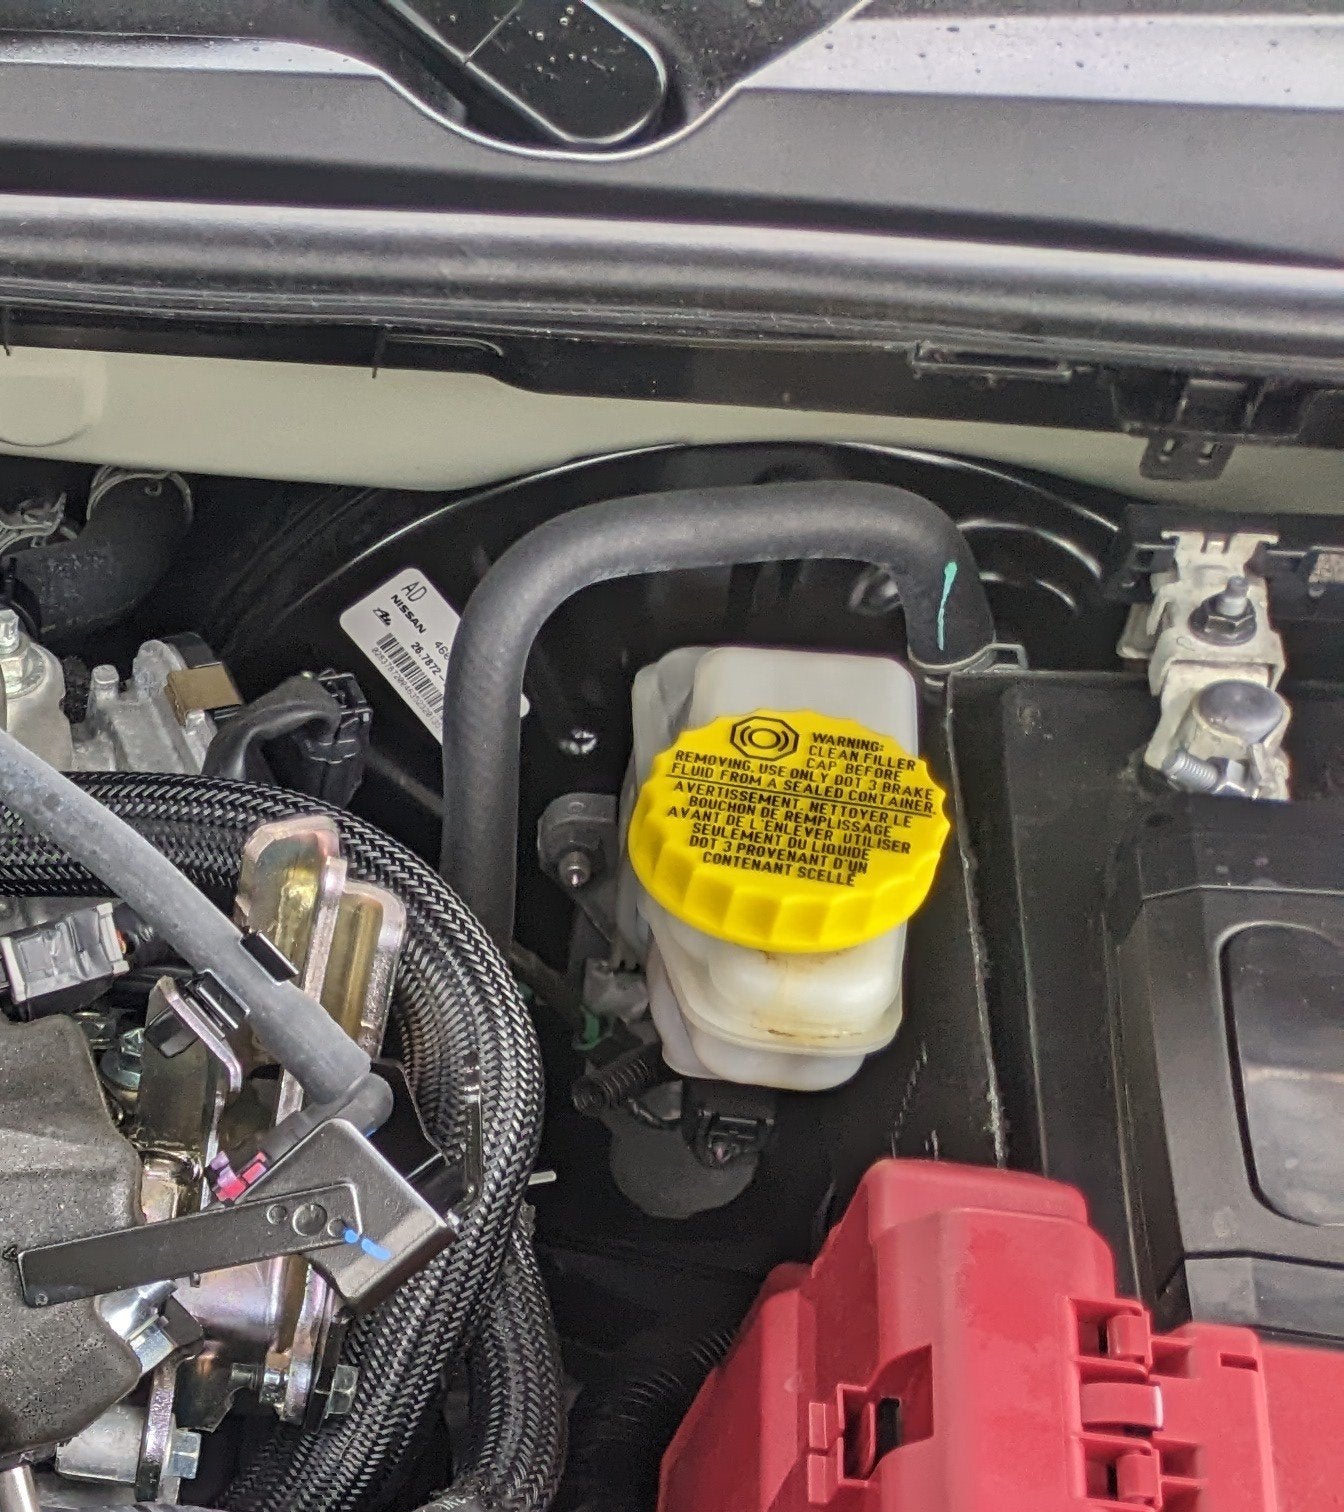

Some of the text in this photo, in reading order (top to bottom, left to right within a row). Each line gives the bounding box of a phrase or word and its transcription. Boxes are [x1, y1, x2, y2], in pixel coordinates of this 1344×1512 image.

[401, 581, 427, 603] AD
[390, 594, 427, 634] NISSAN
[809, 745, 916, 772] CLEAN FILLER
[812, 731, 884, 752] WARNING:
[672, 762, 714, 779] FLUID
[719, 769, 762, 786] FROM
[767, 777, 778, 789] A
[783, 780, 844, 799] SEALED
[759, 763, 786, 778] USE
[790, 767, 828, 784] ONLY
[834, 774, 861, 789] DOT
[868, 779, 878, 791] 3
[882, 781, 933, 800] BRAKE
[806, 758, 902, 783] CAP BEFORE
[666, 805, 722, 823] AVANT
[726, 813, 743, 827] DE
[843, 832, 912, 854] UTILISER
[689, 796, 892, 838] BOUCHON DE REMPLISSAGE
[809, 801, 889, 822] NETTOYER
[893, 814, 913, 828] LE
[689, 836, 868, 875] DOT 3 PROVENANT D'UN
[692, 822, 871, 861] SEULEMENT DU LIQUIDE
[703, 851, 792, 876] CONTENANT
